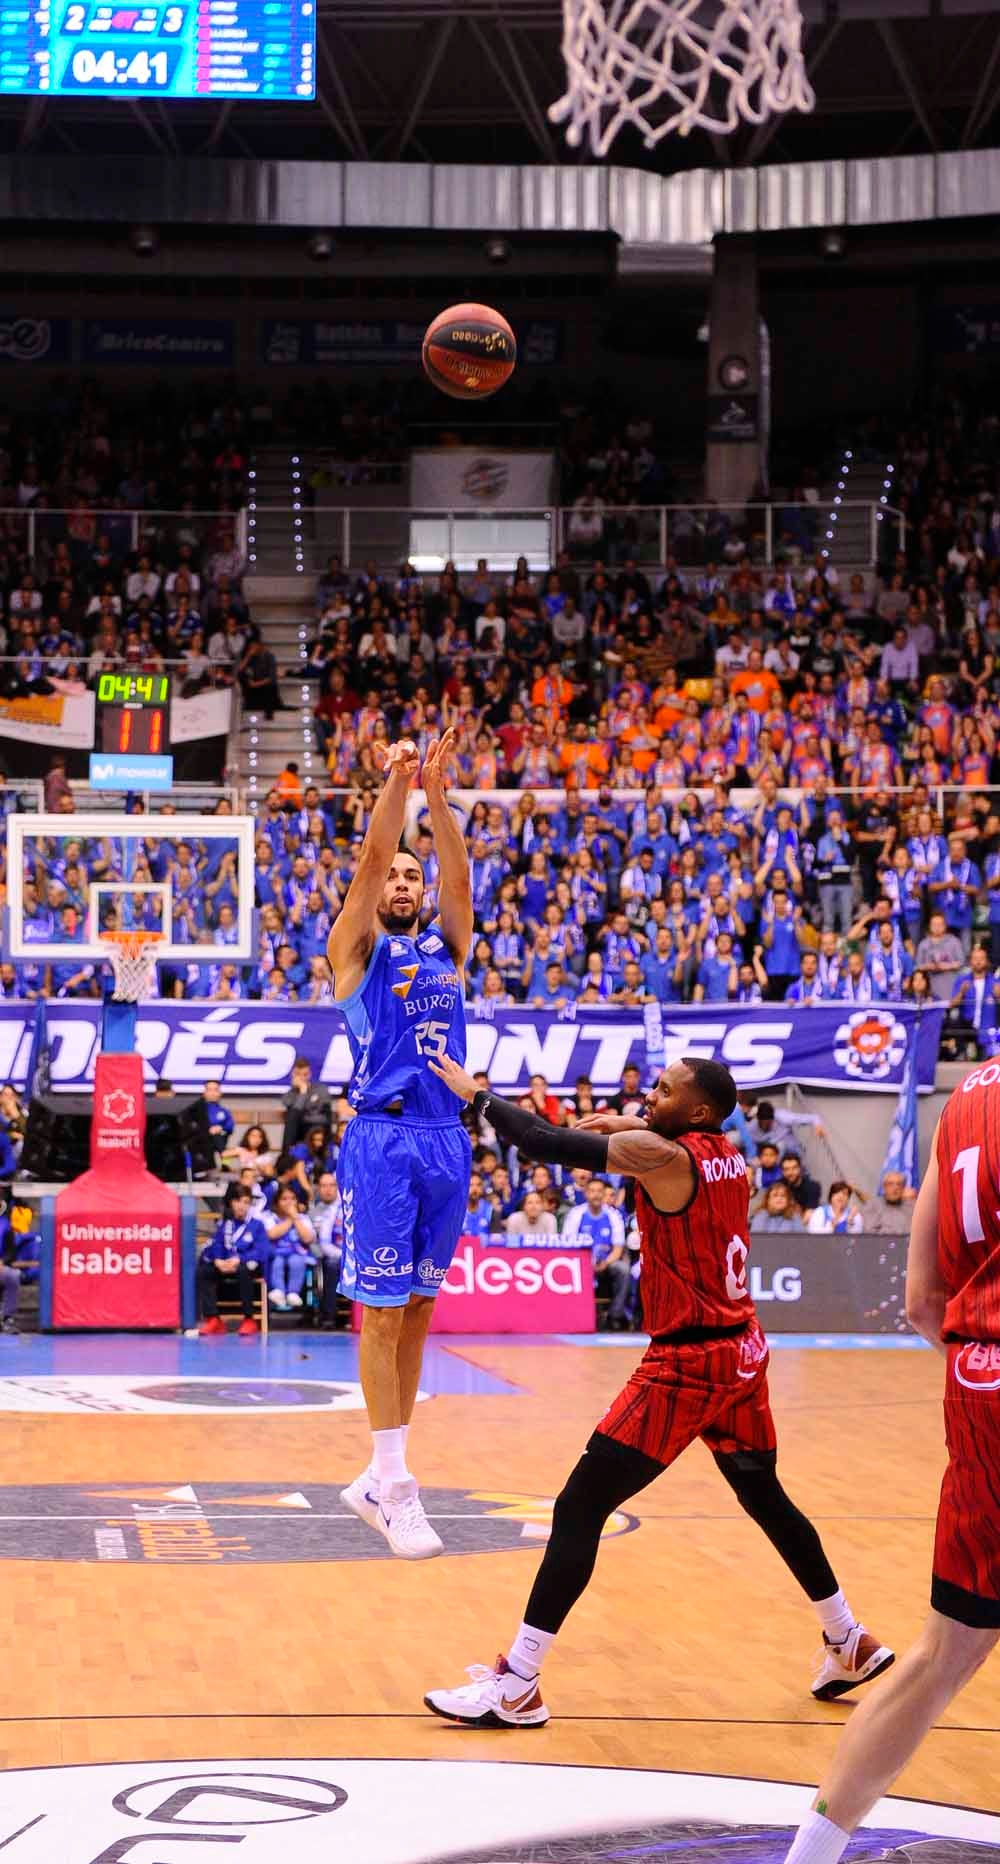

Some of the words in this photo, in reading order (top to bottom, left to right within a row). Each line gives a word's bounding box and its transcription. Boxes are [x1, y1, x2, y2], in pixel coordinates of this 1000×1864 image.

[64, 5, 85, 30] 2
[164, 7, 183, 32] 3
[72, 50, 168, 84] 04:41
[98, 674, 168, 701] 04:41
[119, 710, 163, 753] 11
[963, 1064, 1000, 1093] GO
[61, 1224, 173, 1241] Universidad
[61, 1247, 152, 1275] Isabel
[164, 1247, 173, 1275] I
[357, 1262, 413, 1277] LEXUS
[751, 1267, 802, 1301] LG
